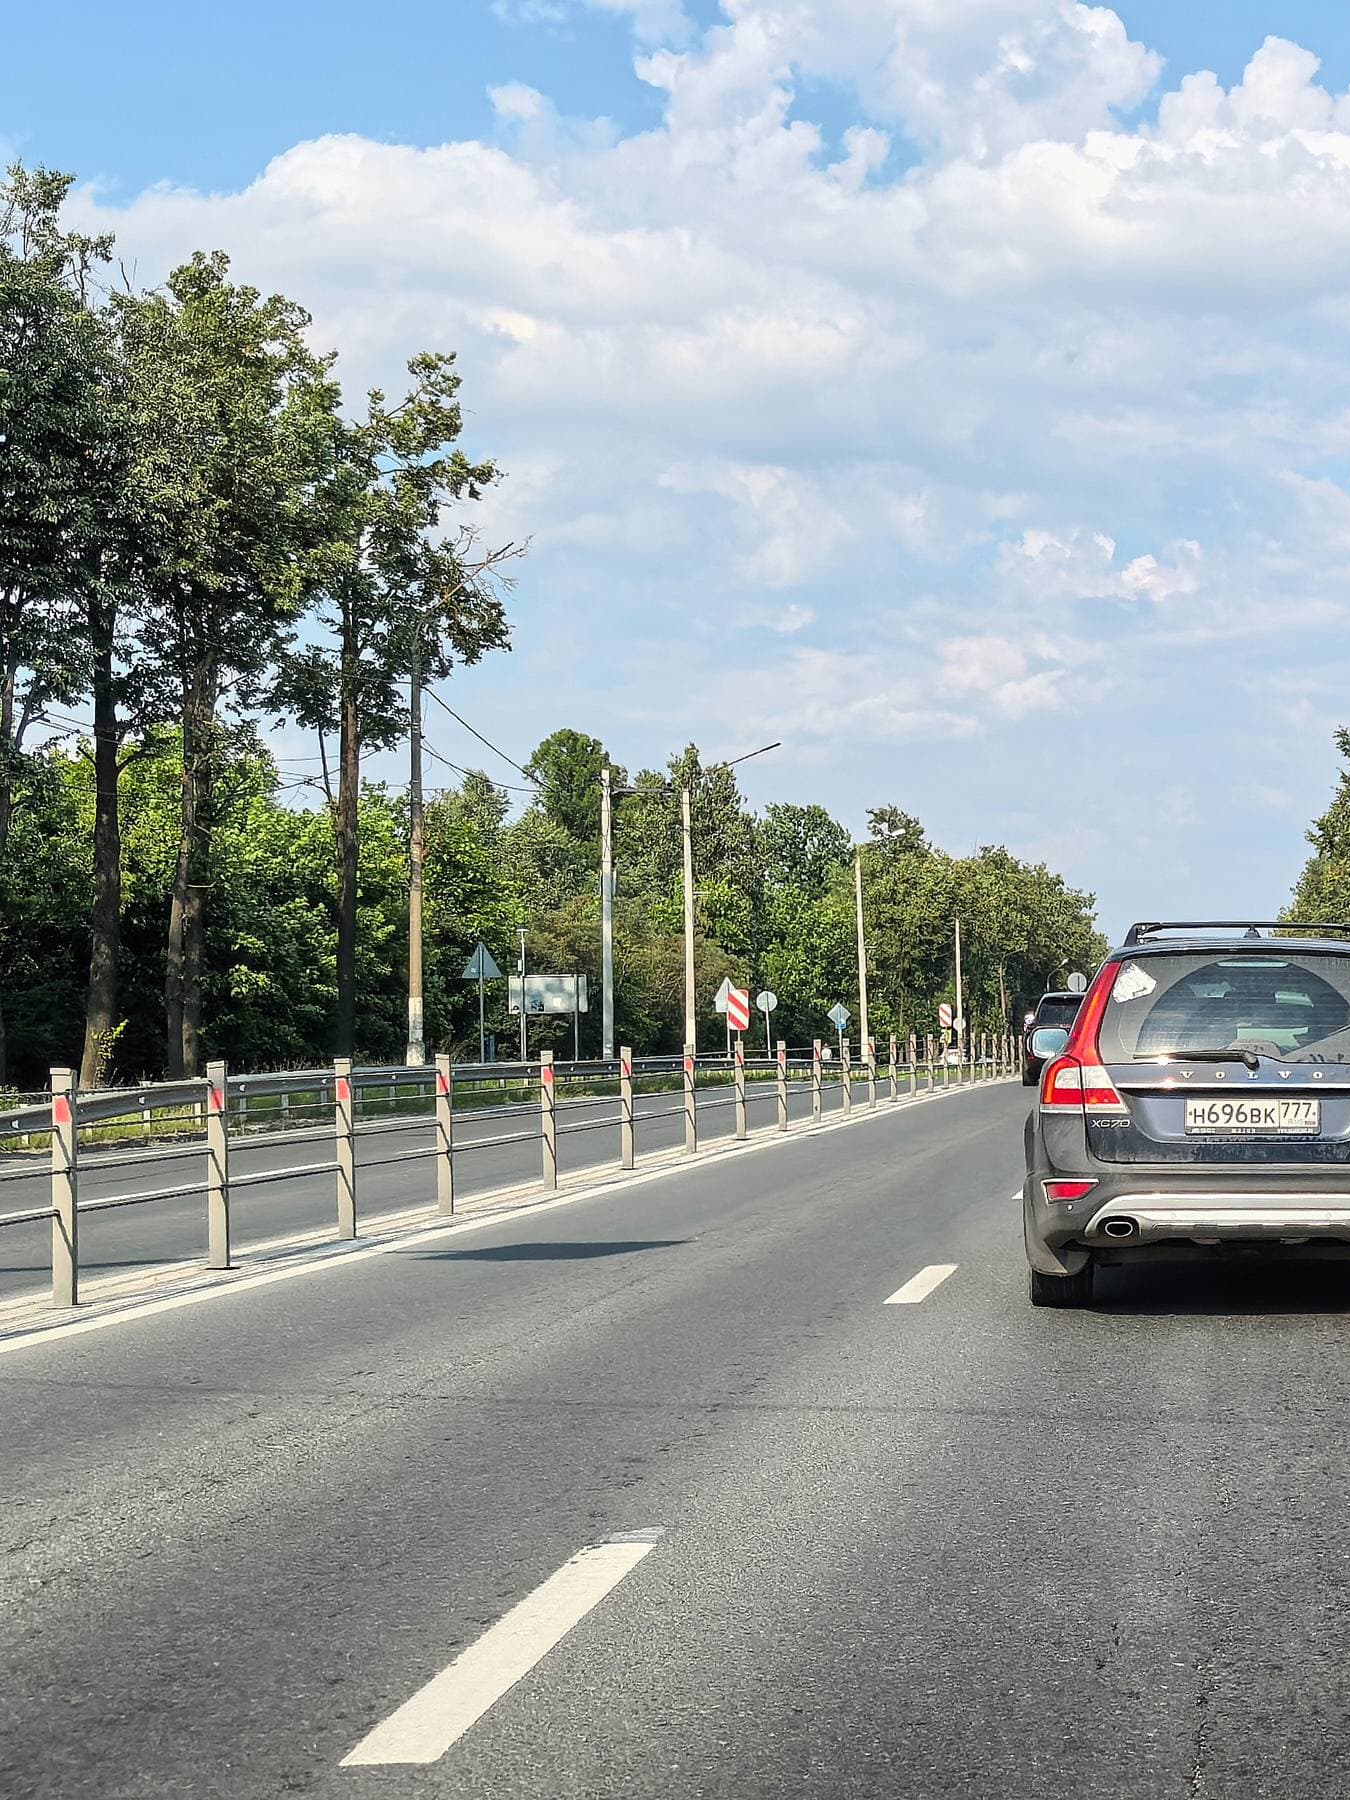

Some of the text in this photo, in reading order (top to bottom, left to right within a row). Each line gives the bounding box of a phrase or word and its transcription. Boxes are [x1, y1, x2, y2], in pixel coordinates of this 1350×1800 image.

[1180, 1071, 1323, 1079] VOLVO
[1281, 1102, 1312, 1118] 777
[1091, 1119, 1131, 1128] XC70
